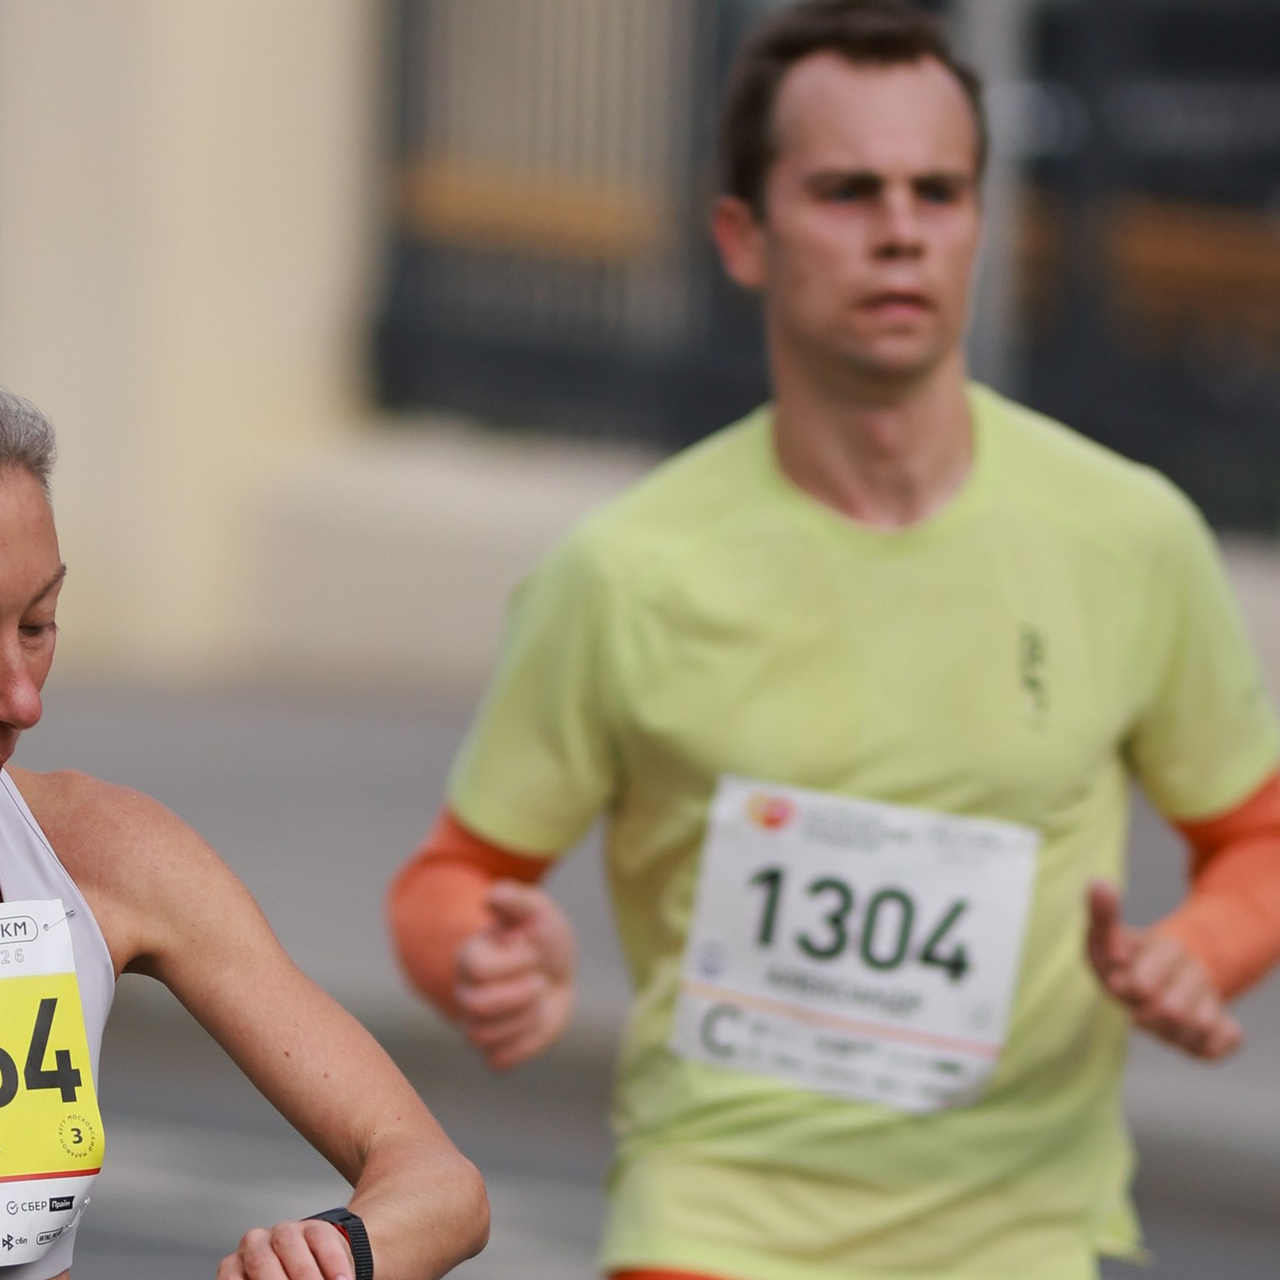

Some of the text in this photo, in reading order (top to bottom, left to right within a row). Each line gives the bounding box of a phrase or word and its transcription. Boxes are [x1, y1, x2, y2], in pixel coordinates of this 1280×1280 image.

[0, 921, 28, 938] КМ
[748, 866, 969, 984] 1304
[70, 1127, 83, 1144] 3
[21, 1201, 47, 1212] СБЕР
